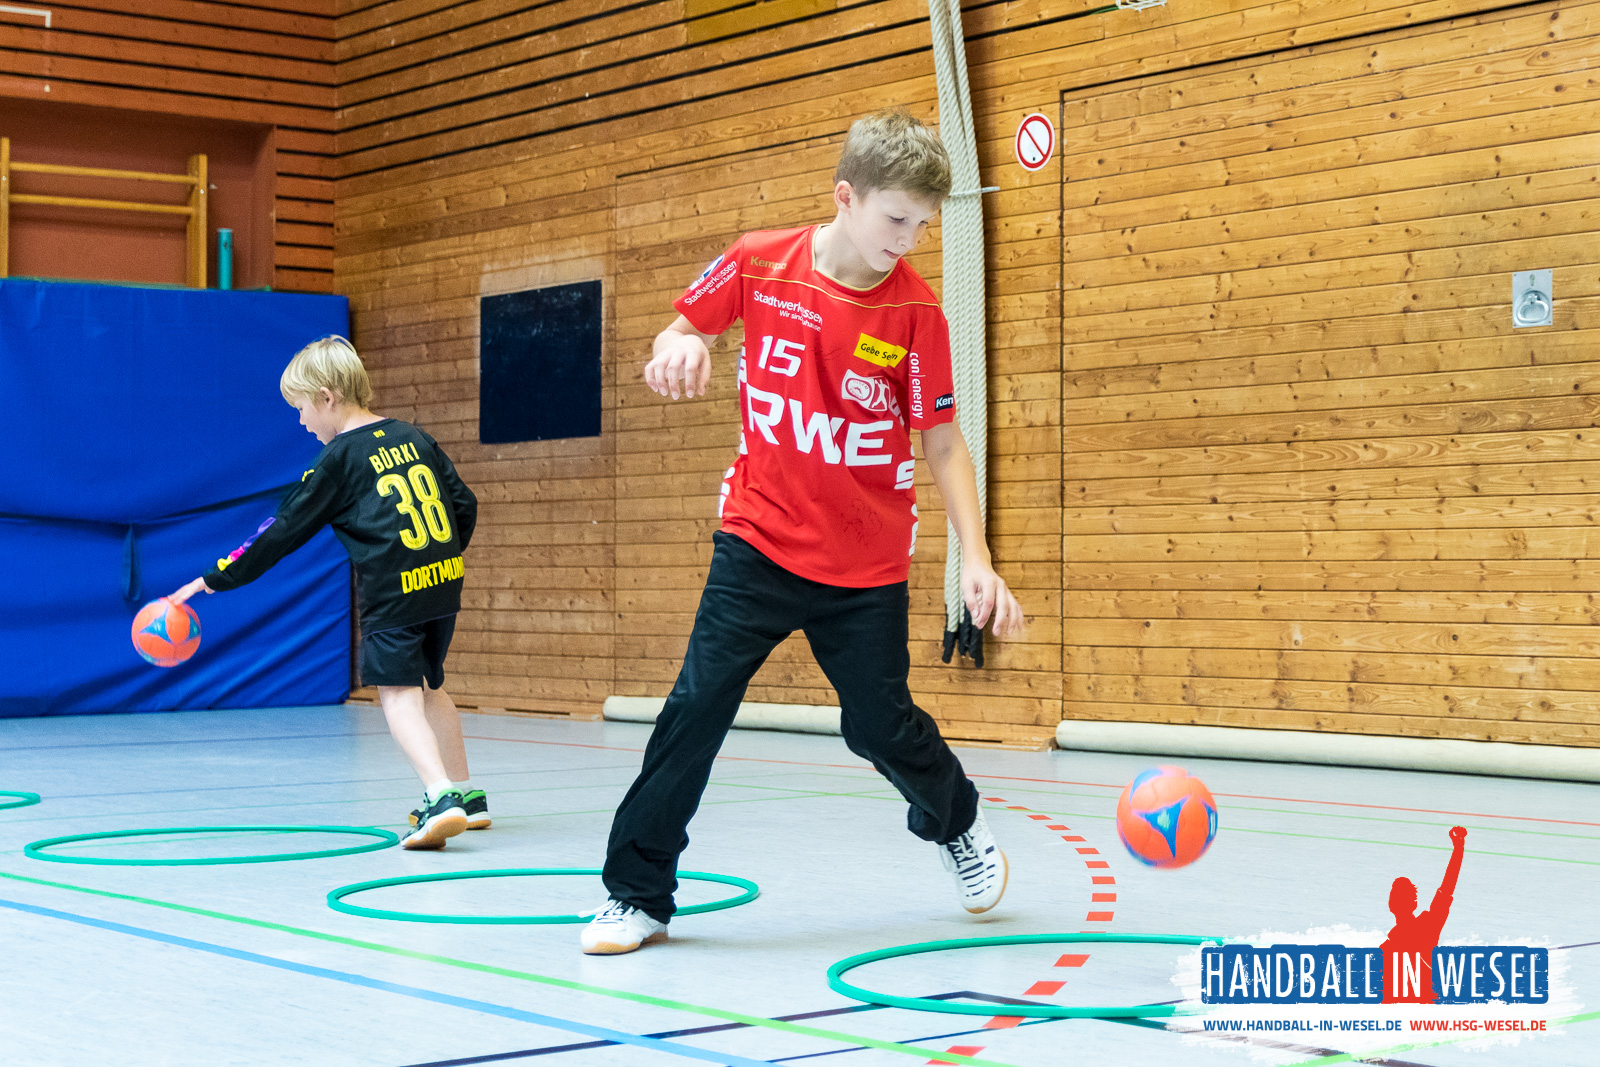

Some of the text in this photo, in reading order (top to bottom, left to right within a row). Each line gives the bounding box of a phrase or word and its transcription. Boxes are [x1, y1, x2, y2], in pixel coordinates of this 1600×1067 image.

[750, 256, 787, 271] Kempa
[780, 309, 791, 318] Wir
[757, 335, 806, 377] 15
[746, 383, 894, 466] RWE
[369, 442, 420, 474] BÜRKI
[376, 464, 453, 550] 38
[400, 556, 465, 594] DORTMUN
